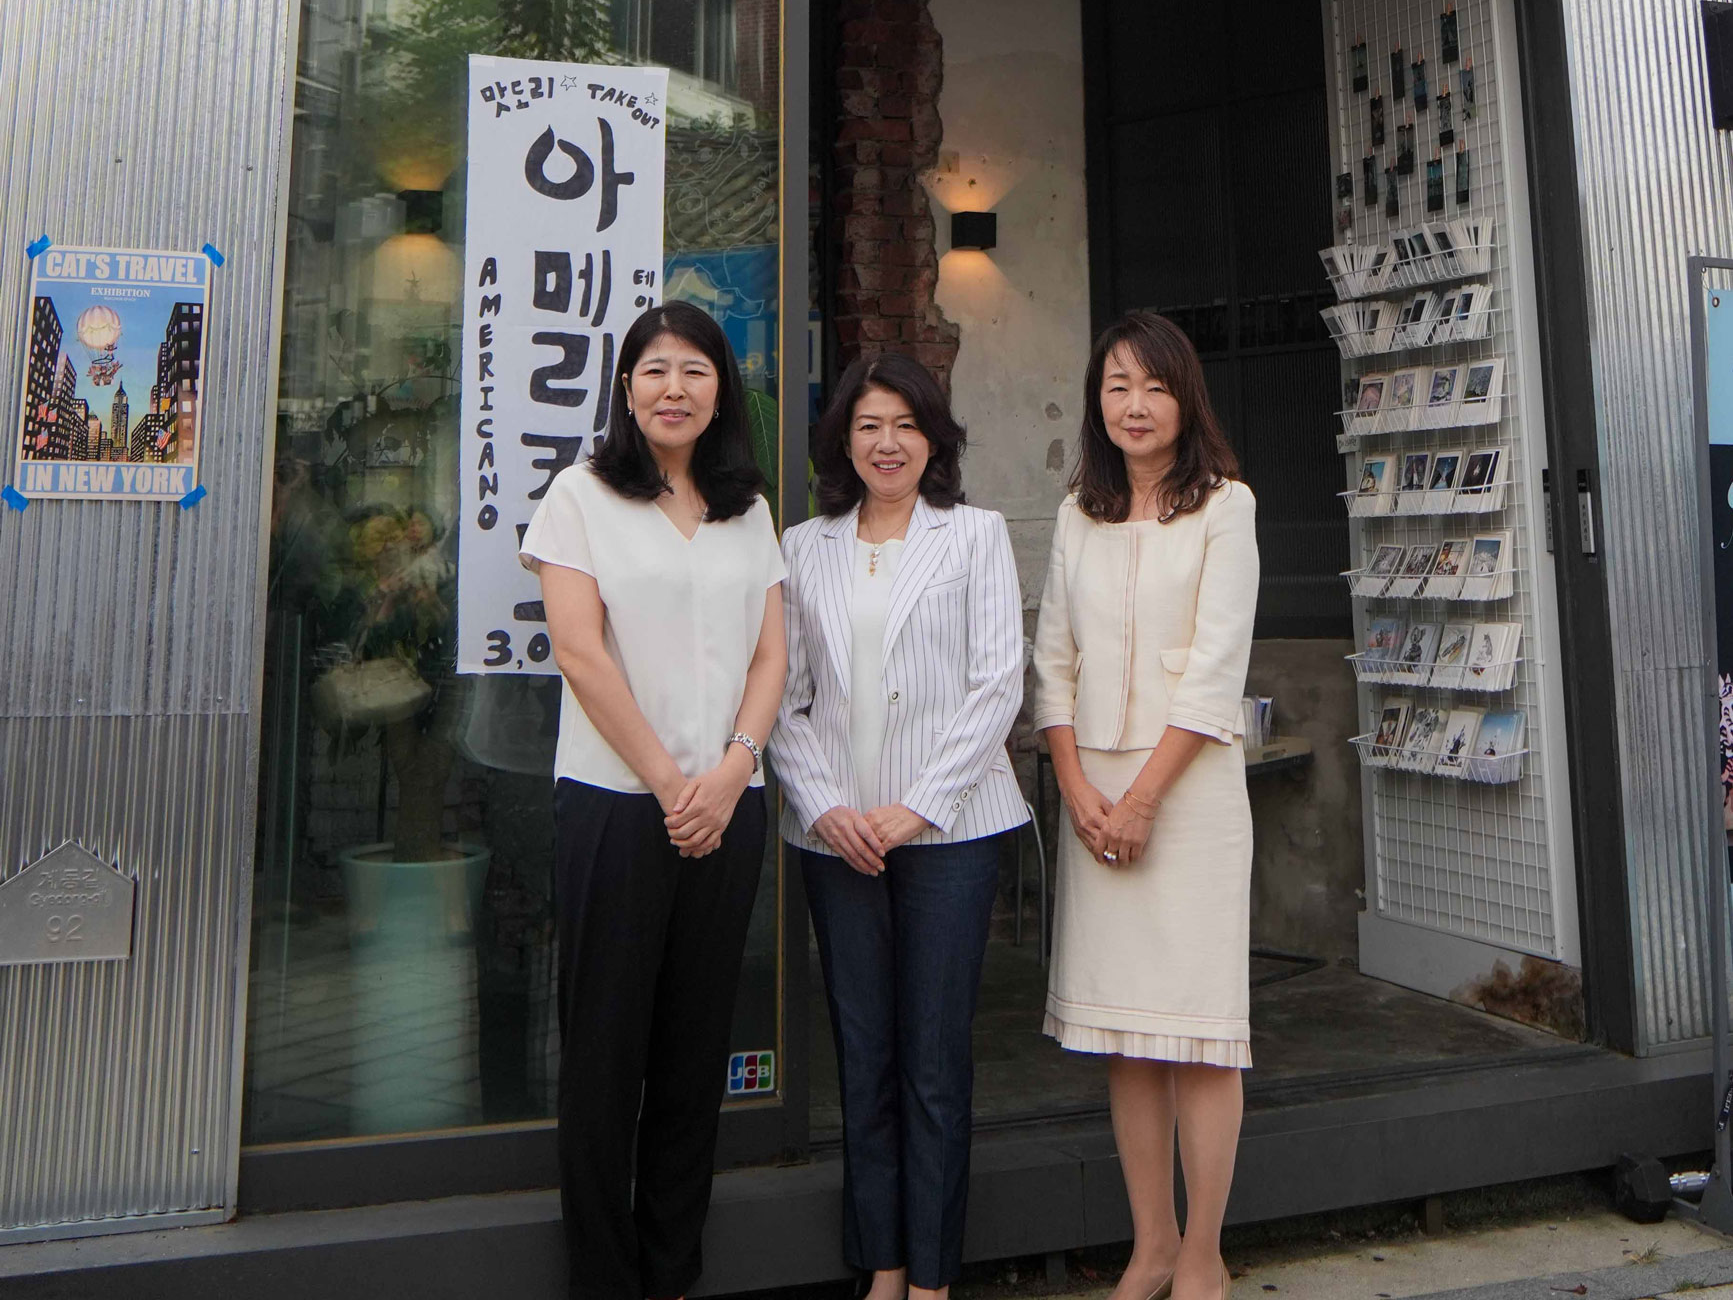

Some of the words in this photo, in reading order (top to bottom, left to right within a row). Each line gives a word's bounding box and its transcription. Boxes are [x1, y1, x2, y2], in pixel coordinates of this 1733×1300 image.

[480, 77, 554, 118] 맛도리
[587, 84, 638, 108] TAKE
[631, 108, 660, 129] OUT
[45, 252, 110, 279] CAT'S
[116, 256, 197, 283] TRAVEL
[91, 287, 151, 298] EXHIBITION
[477, 257, 501, 530] AMERICANO
[26, 465, 51, 491] IN
[58, 466, 116, 492] NEW
[121, 467, 187, 493] YORK
[46, 914, 84, 943] 92
[730, 1065, 770, 1079] JCB
